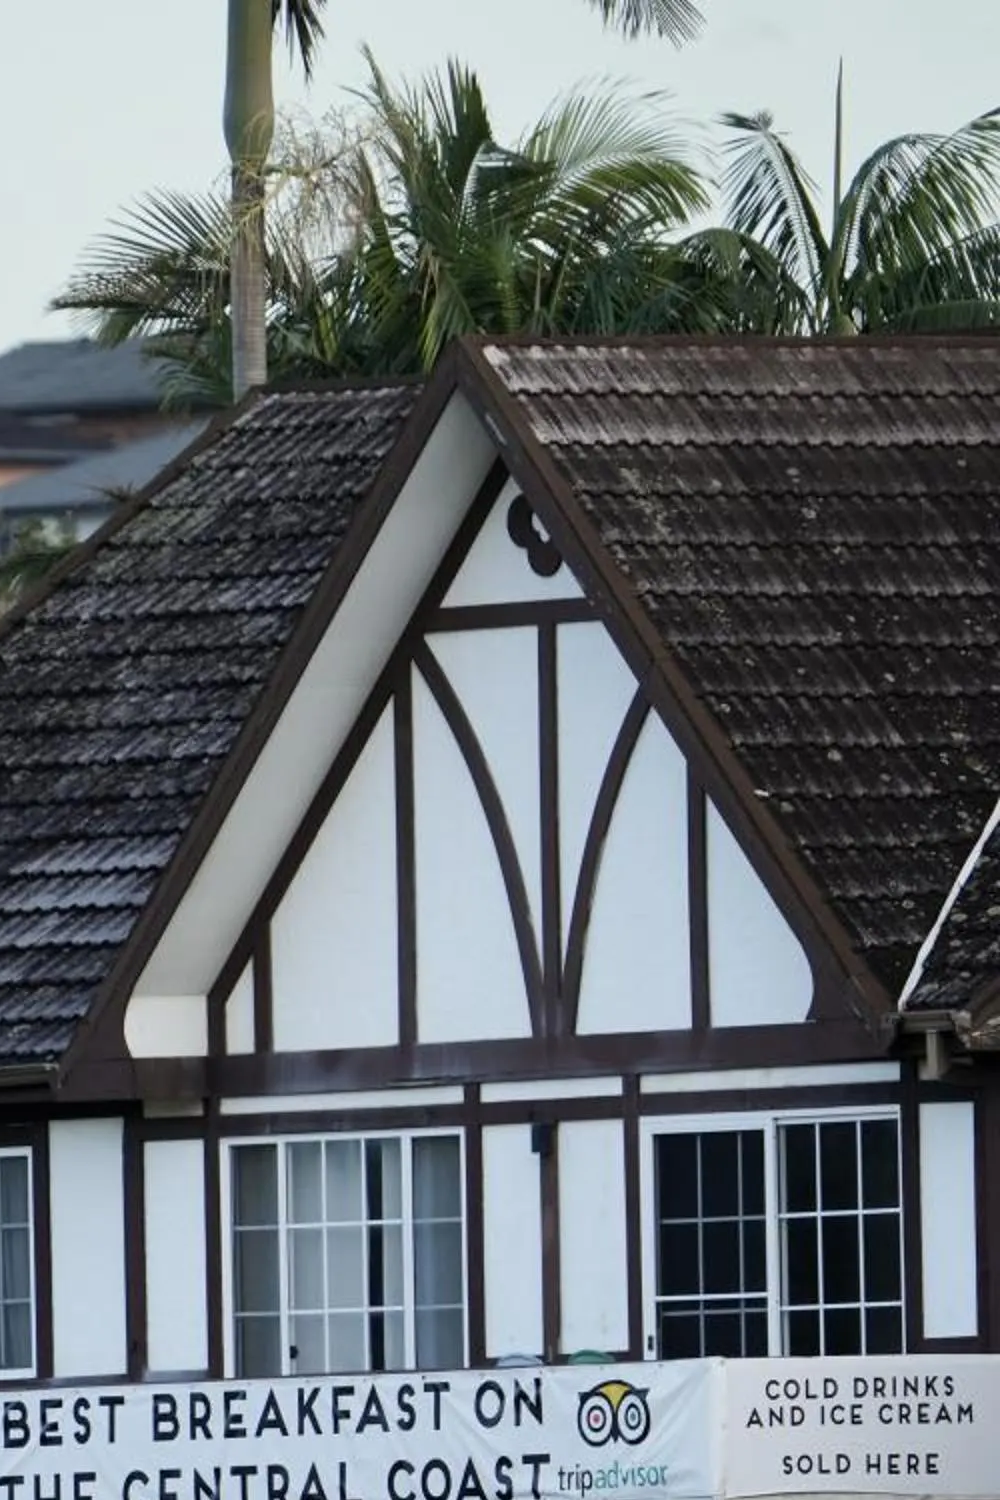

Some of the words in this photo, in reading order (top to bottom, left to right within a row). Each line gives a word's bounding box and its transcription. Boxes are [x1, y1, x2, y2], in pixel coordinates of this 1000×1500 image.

[765, 1377, 839, 1400] COLD
[853, 1375, 955, 1399] DRINKS
[3, 1396, 125, 1448] BEST
[152, 1381, 451, 1442] BREAKFAST
[474, 1377, 544, 1429] ON
[746, 1405, 806, 1429] AND
[820, 1403, 864, 1426] ICE
[878, 1402, 974, 1425] CREAM
[782, 1453, 850, 1475] SOLD
[866, 1453, 940, 1475] HERE
[557, 1459, 668, 1498] tripadvisor
